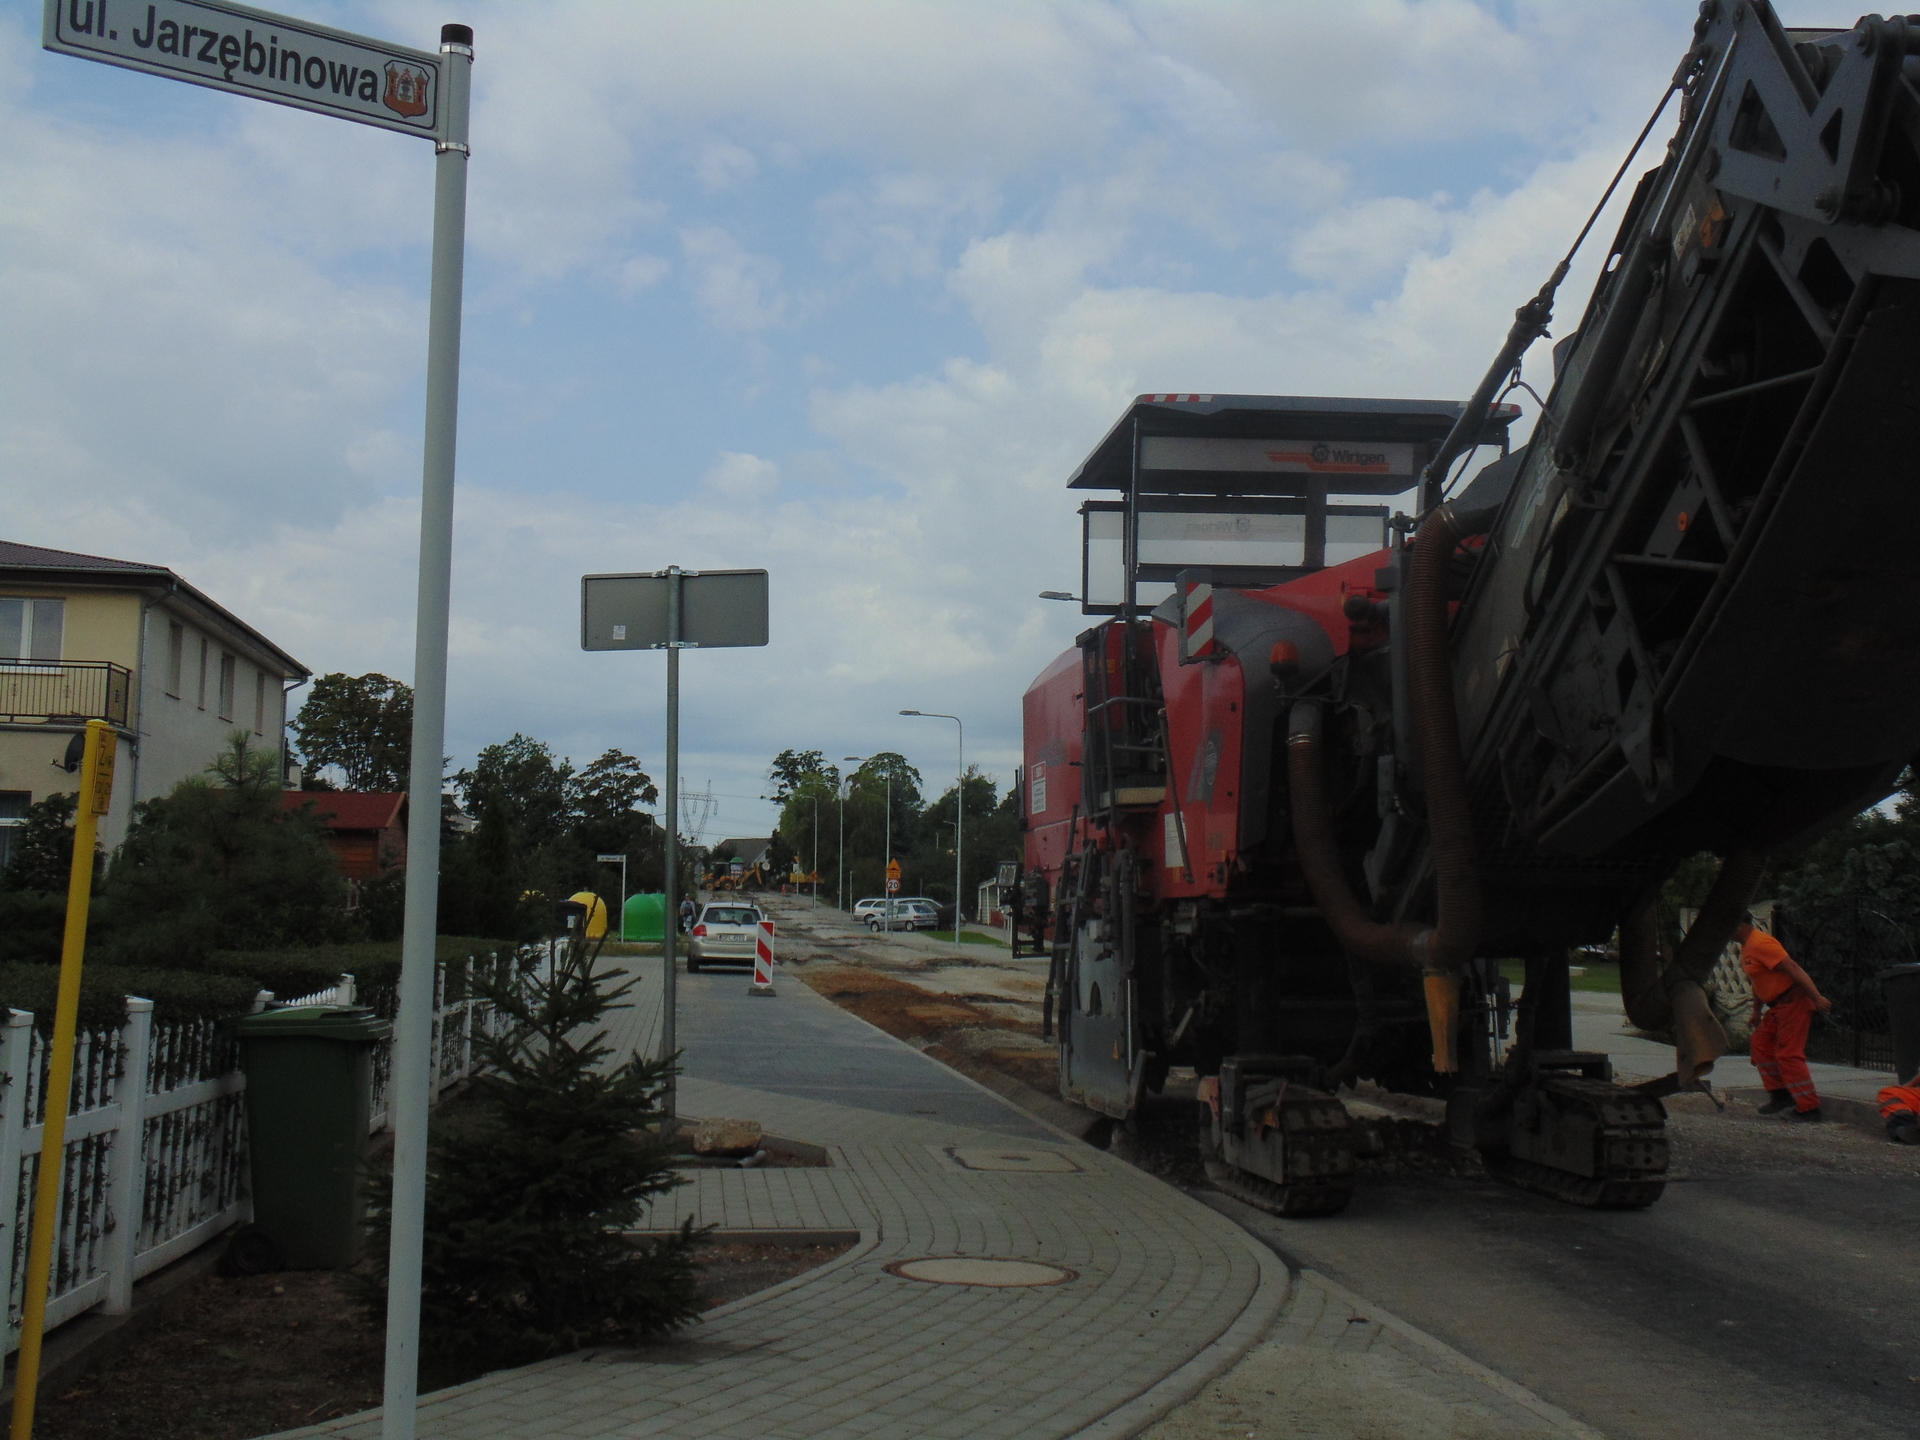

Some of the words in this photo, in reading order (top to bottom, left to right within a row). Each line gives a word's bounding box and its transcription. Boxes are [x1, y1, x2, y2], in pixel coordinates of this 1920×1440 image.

[69, 0, 117, 41] ul.
[132, 4, 379, 104] Jarzębinowa
[1332, 449, 1386, 465] Wirtgen
[889, 881, 898, 889] 20
